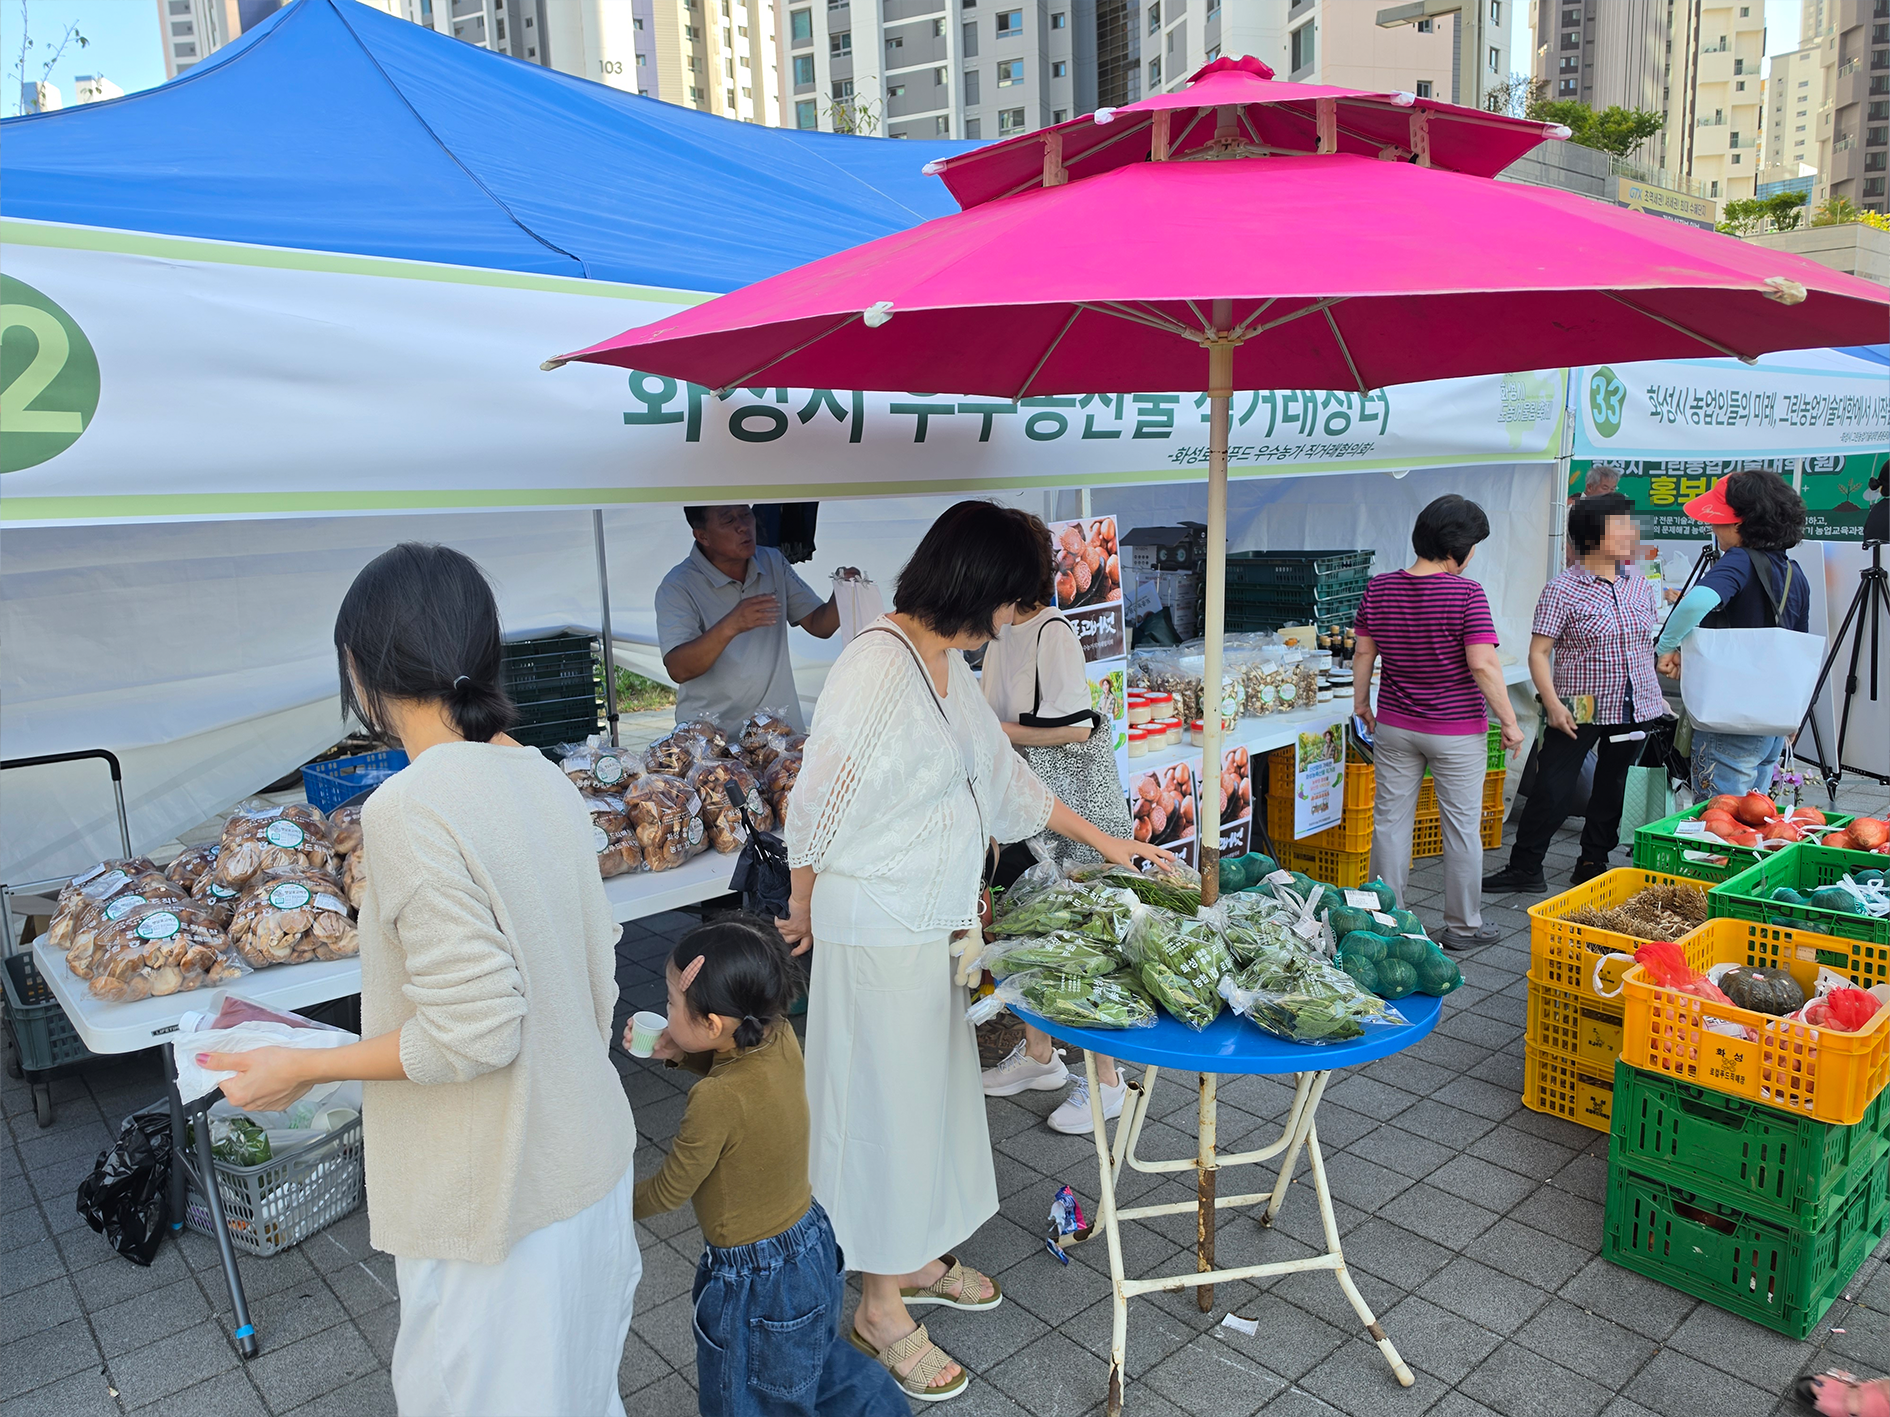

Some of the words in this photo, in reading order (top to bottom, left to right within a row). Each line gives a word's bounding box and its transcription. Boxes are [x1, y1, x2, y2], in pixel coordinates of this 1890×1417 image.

[599, 60, 623, 74] 103
[623, 371, 865, 443] 화성시
[1592, 376, 1625, 424] 33
[1647, 385, 1689, 425] 화성시
[1690, 387, 1752, 427] 농업인들의
[1753, 391, 1778, 429] 미래,
[1872, 395, 1890, 427] 시작
[1254, 443, 1305, 461] 우수농가
[1649, 476, 1719, 504] 홍보
[1662, 526, 1690, 535] 문제해결
[1180, 957, 1198, 974] 화성
[1192, 973, 1210, 989] 농협
